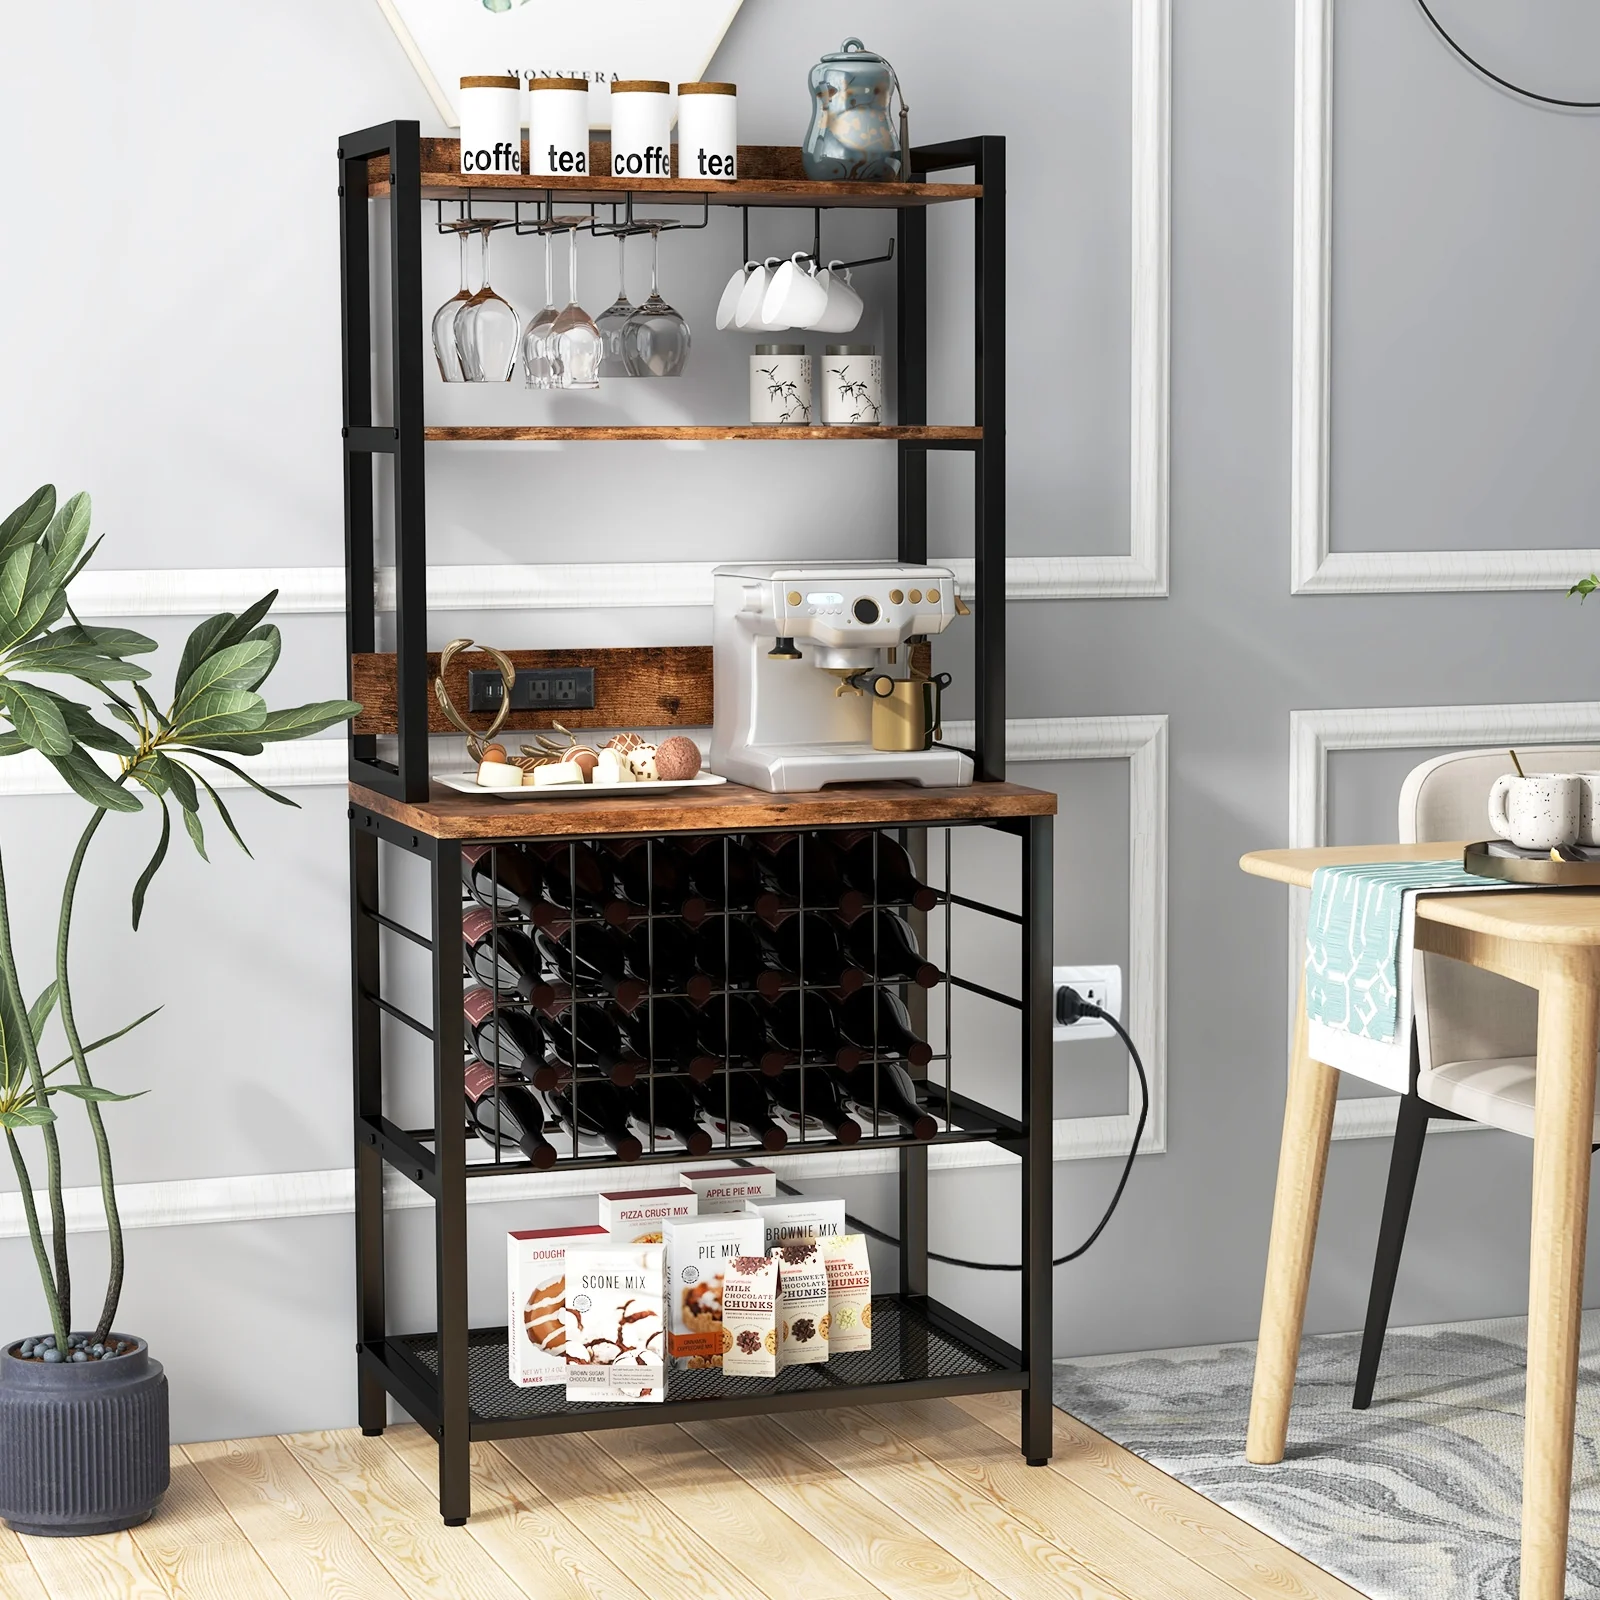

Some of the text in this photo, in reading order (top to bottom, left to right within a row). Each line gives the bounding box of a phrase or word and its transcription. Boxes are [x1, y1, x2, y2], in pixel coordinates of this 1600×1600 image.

[507, 69, 620, 83] MONSTERA
[463, 142, 520, 172] coffe
[548, 144, 586, 173] tea
[614, 146, 669, 175] coffe
[697, 148, 734, 176] tea
[706, 1185, 762, 1198] APPLE PIE MIX
[620, 1206, 689, 1220] PIZZA CRUST MIX
[766, 1223, 838, 1241] BROWNIE MIX
[698, 1243, 741, 1259] PIE MIX
[827, 1270, 869, 1278] HOCOLATE
[582, 1275, 646, 1289] SCONE MIX
[828, 1277, 869, 1287] HUNKS
[724, 1300, 773, 1309] CHUNKS
